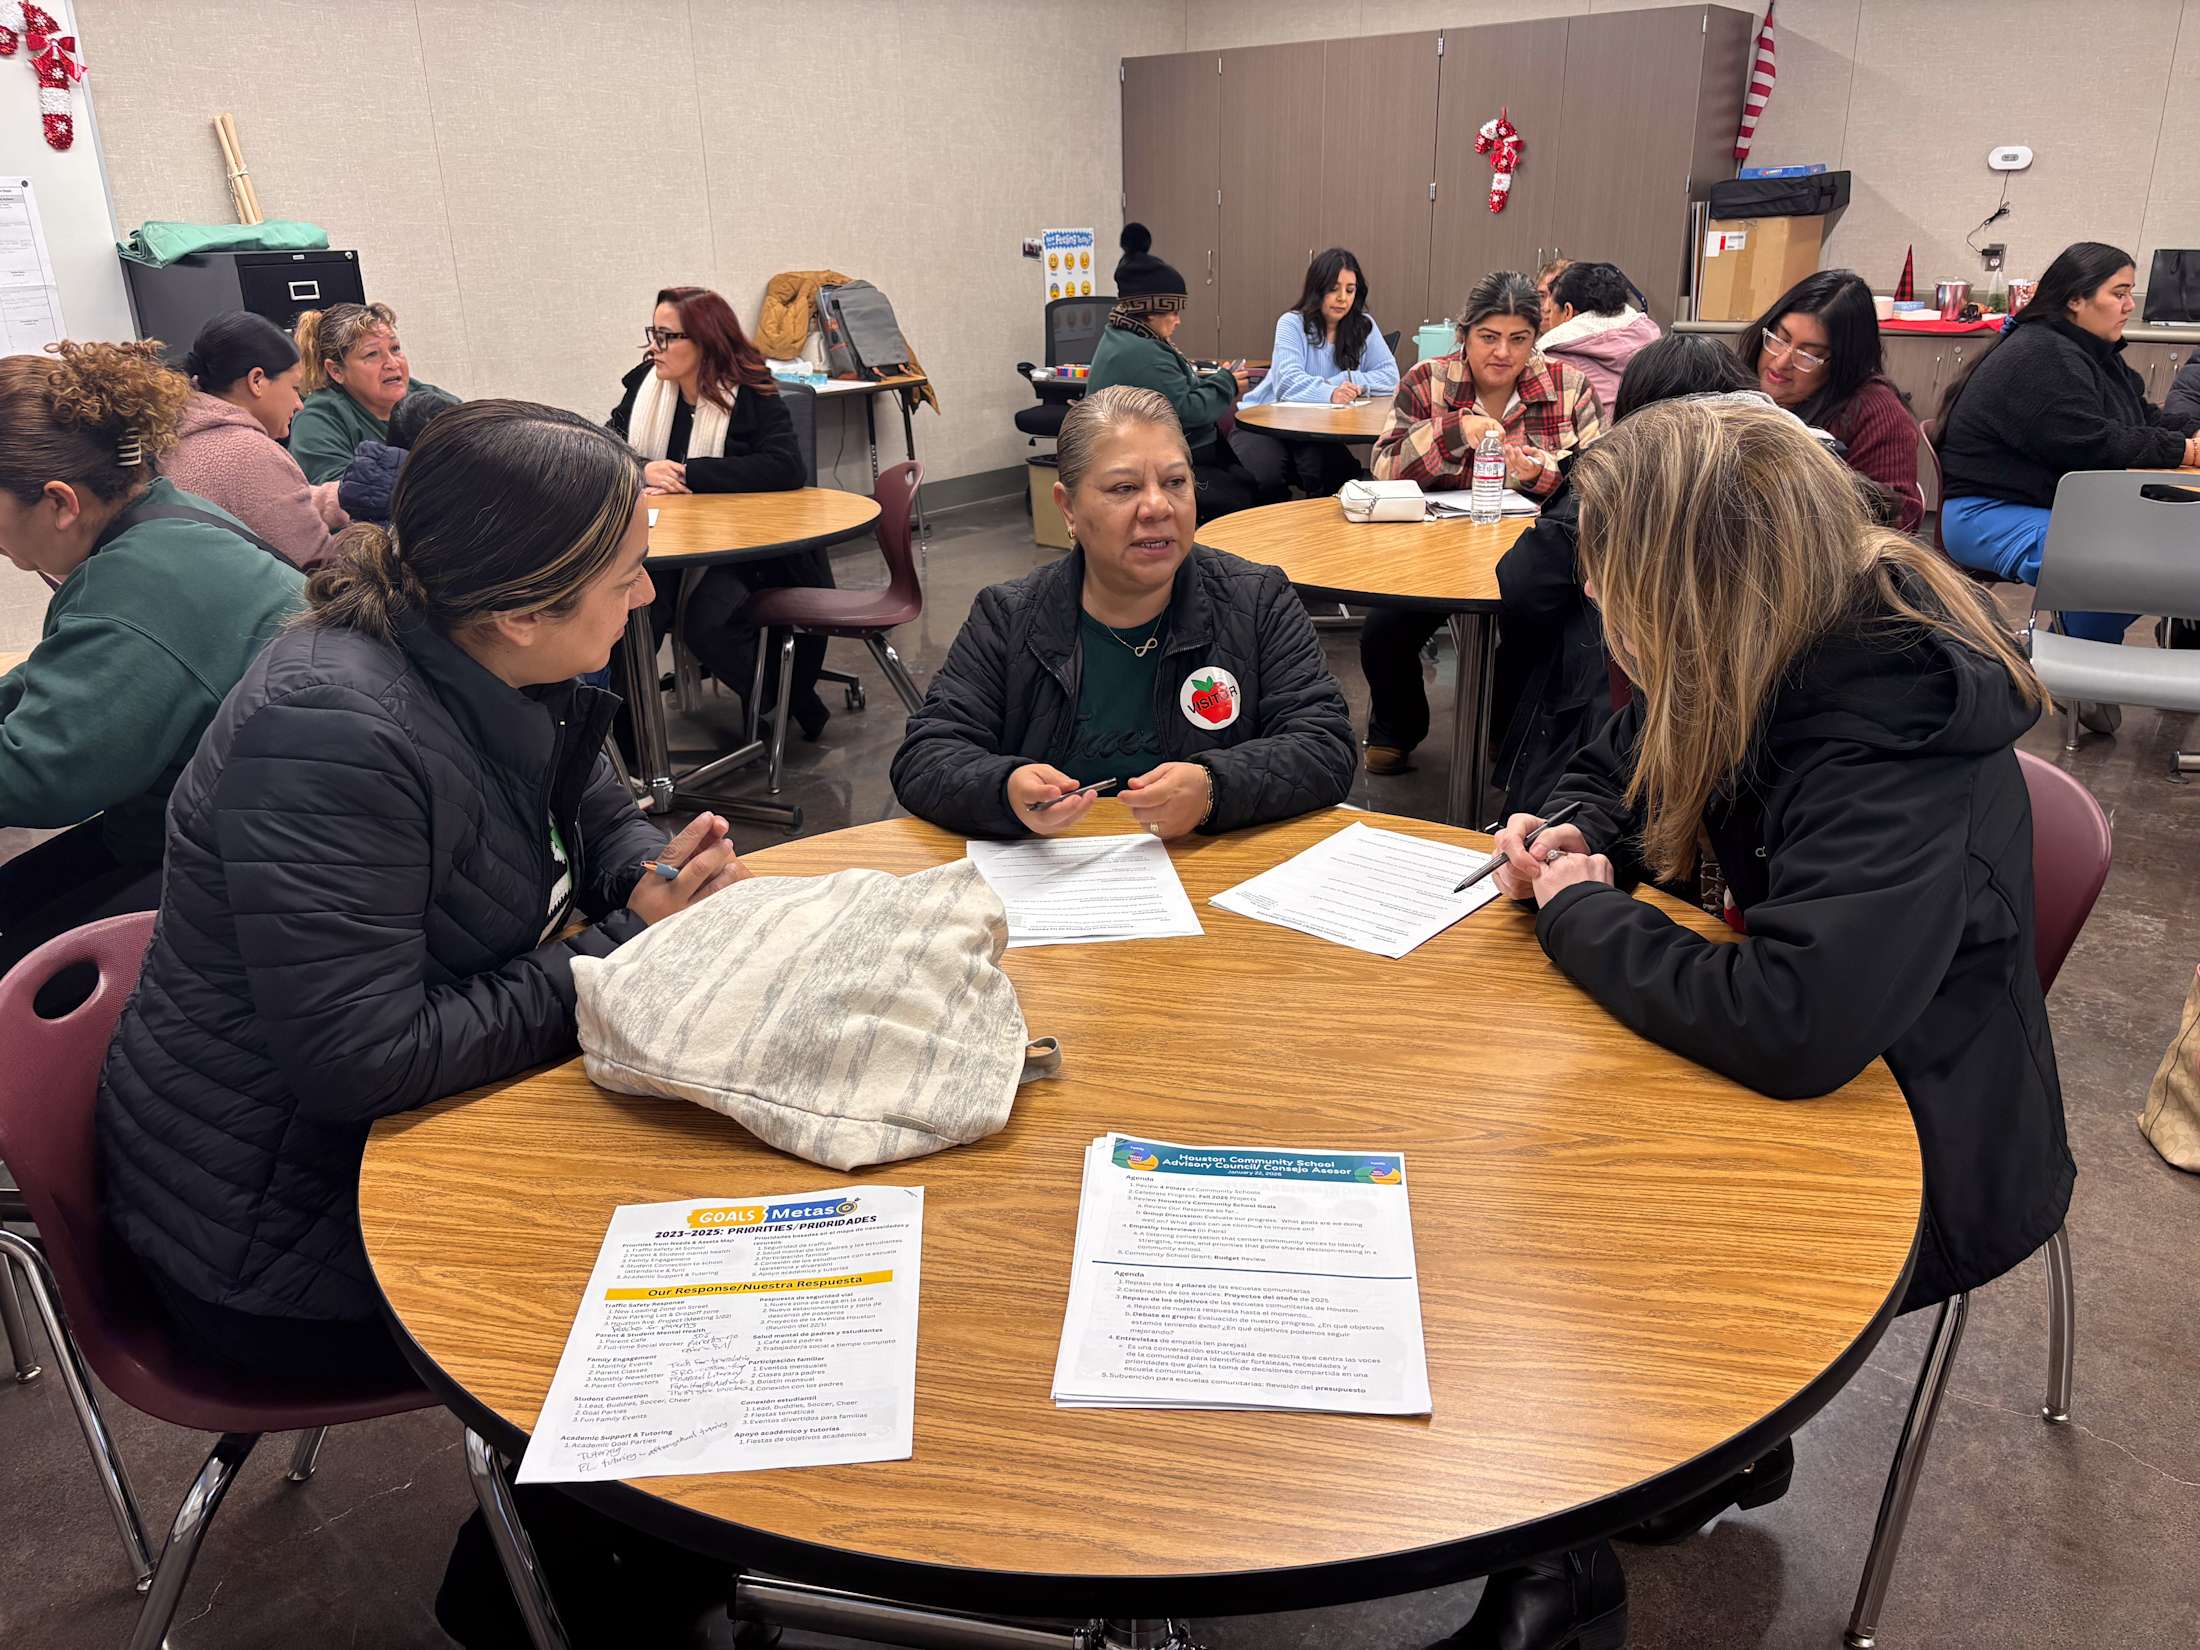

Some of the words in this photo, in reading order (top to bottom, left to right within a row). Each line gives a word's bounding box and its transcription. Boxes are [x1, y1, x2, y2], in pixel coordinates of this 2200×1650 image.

[1188, 686, 1238, 714] VISITOR
[1162, 1158, 1212, 1168] Advisory
[1215, 1161, 1259, 1170] Council/
[1263, 1164, 1310, 1173] Consejo
[1313, 1166, 1351, 1175] Asesor
[1179, 1153, 1225, 1162] Houston
[1230, 1156, 1293, 1166] Community
[1297, 1160, 1334, 1168] School
[699, 1210, 755, 1223] GOALS
[772, 1206, 834, 1219] Metas
[728, 1215, 876, 1235] PRIORITIES/PRIORIDADES
[676, 1282, 792, 1295] Response/Nuestra
[796, 1276, 862, 1288] Respuesta
[822, 1431, 866, 1439] académicos
